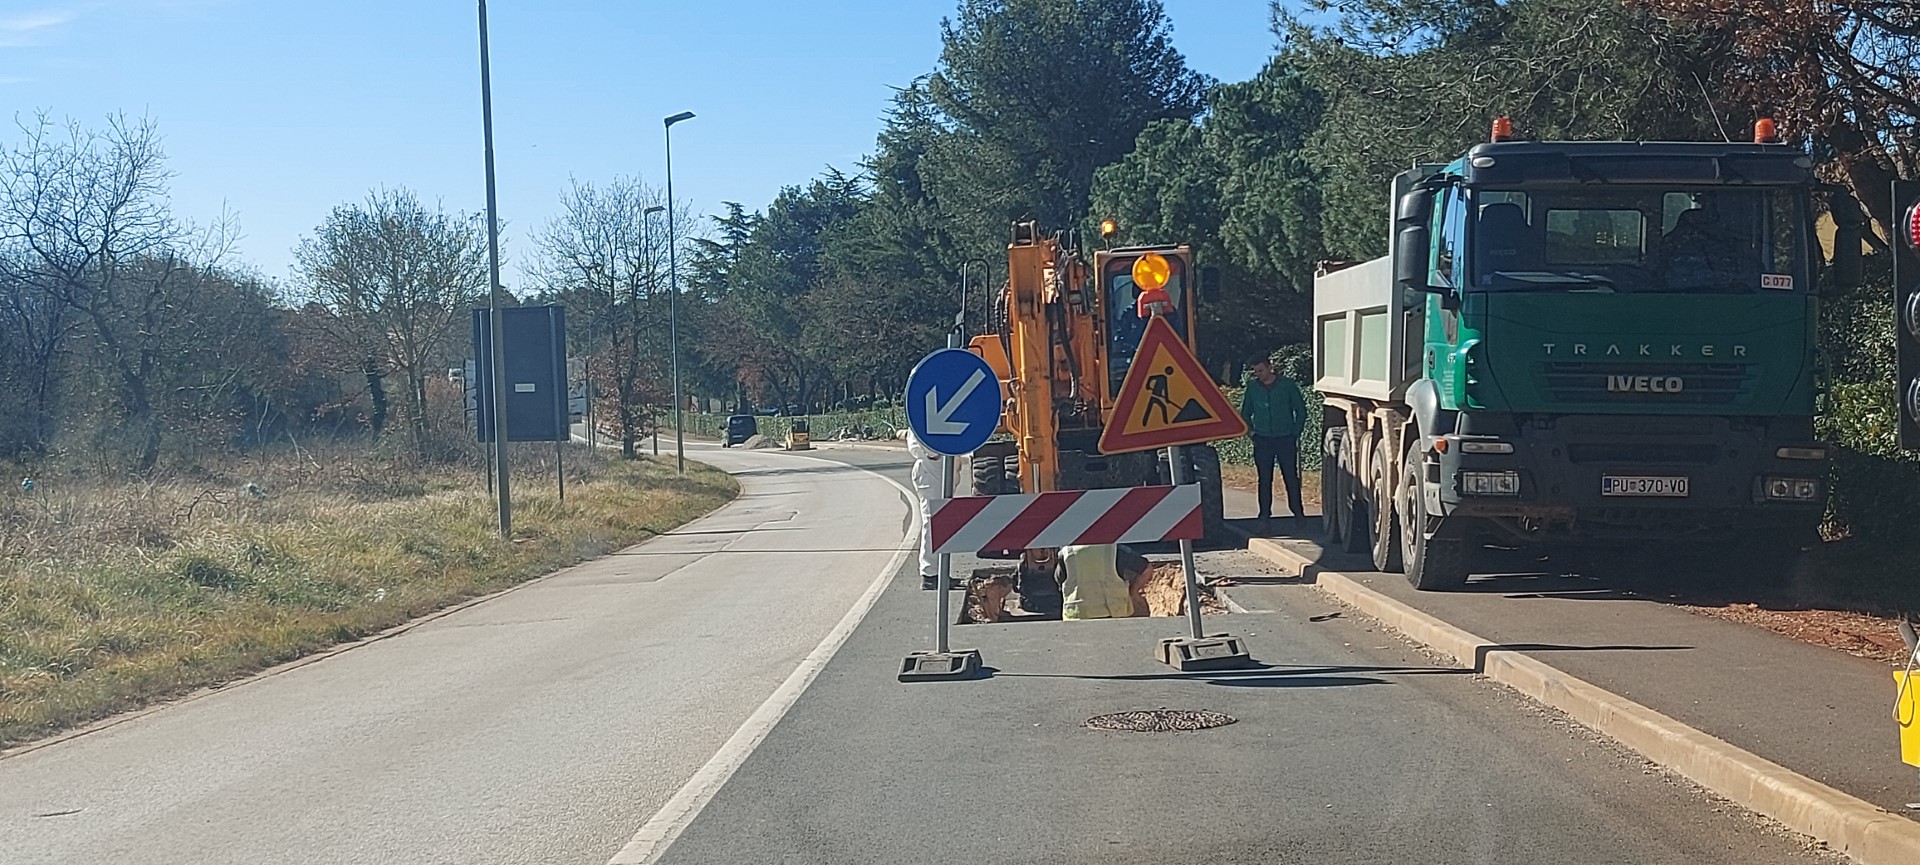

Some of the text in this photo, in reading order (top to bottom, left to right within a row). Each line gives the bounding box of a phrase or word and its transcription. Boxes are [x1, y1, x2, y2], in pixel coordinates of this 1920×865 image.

[1763, 276, 1791, 287] C 077
[1543, 343, 1746, 357] TRAKKER
[1607, 375, 1683, 393] IVECO
[1612, 479, 1629, 493] PU
